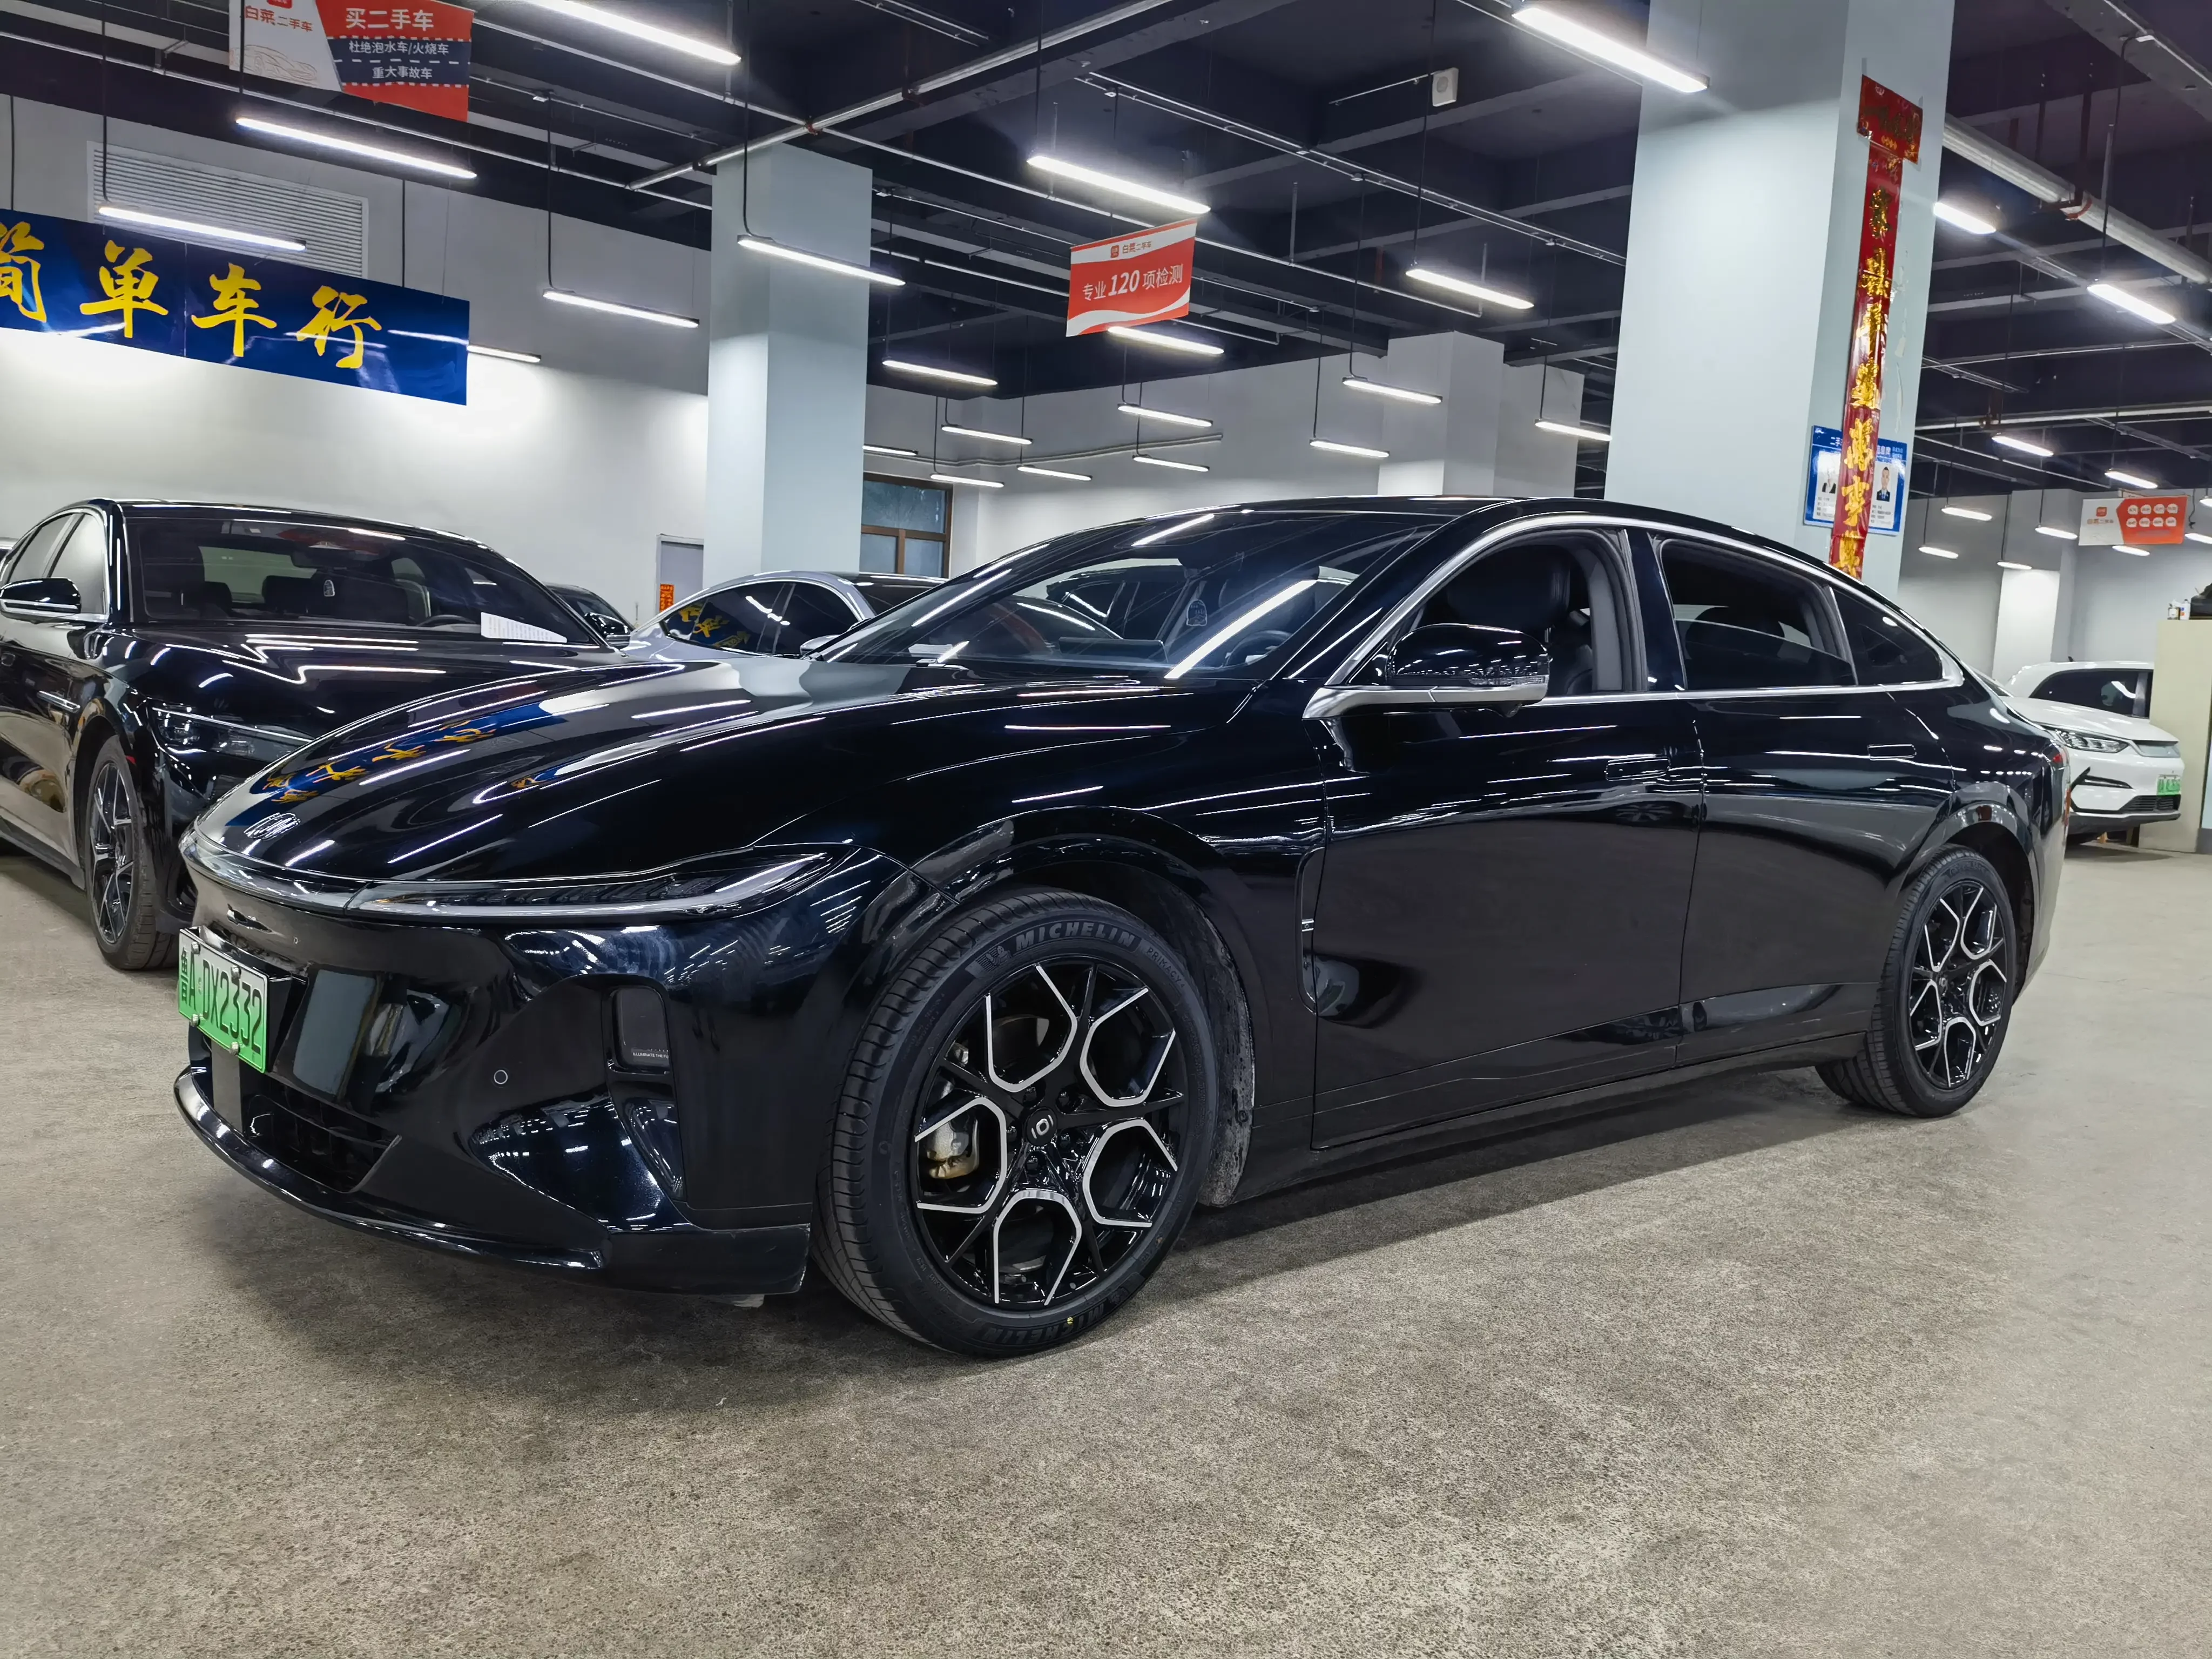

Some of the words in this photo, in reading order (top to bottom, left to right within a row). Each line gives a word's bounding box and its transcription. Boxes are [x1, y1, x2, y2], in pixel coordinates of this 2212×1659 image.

[245, 5, 313, 32] 白菜二手车
[346, 8, 434, 31] 买二手车
[349, 41, 449, 55] 杜绝泡水车/火烧车
[372, 66, 433, 79] 重大事故车
[0, 221, 382, 369] 简单车行
[1082, 264, 1183, 301] 专业120项检测
[1016, 921, 1135, 951] MICHELIN
[1147, 947, 1183, 983] PRIMACY
